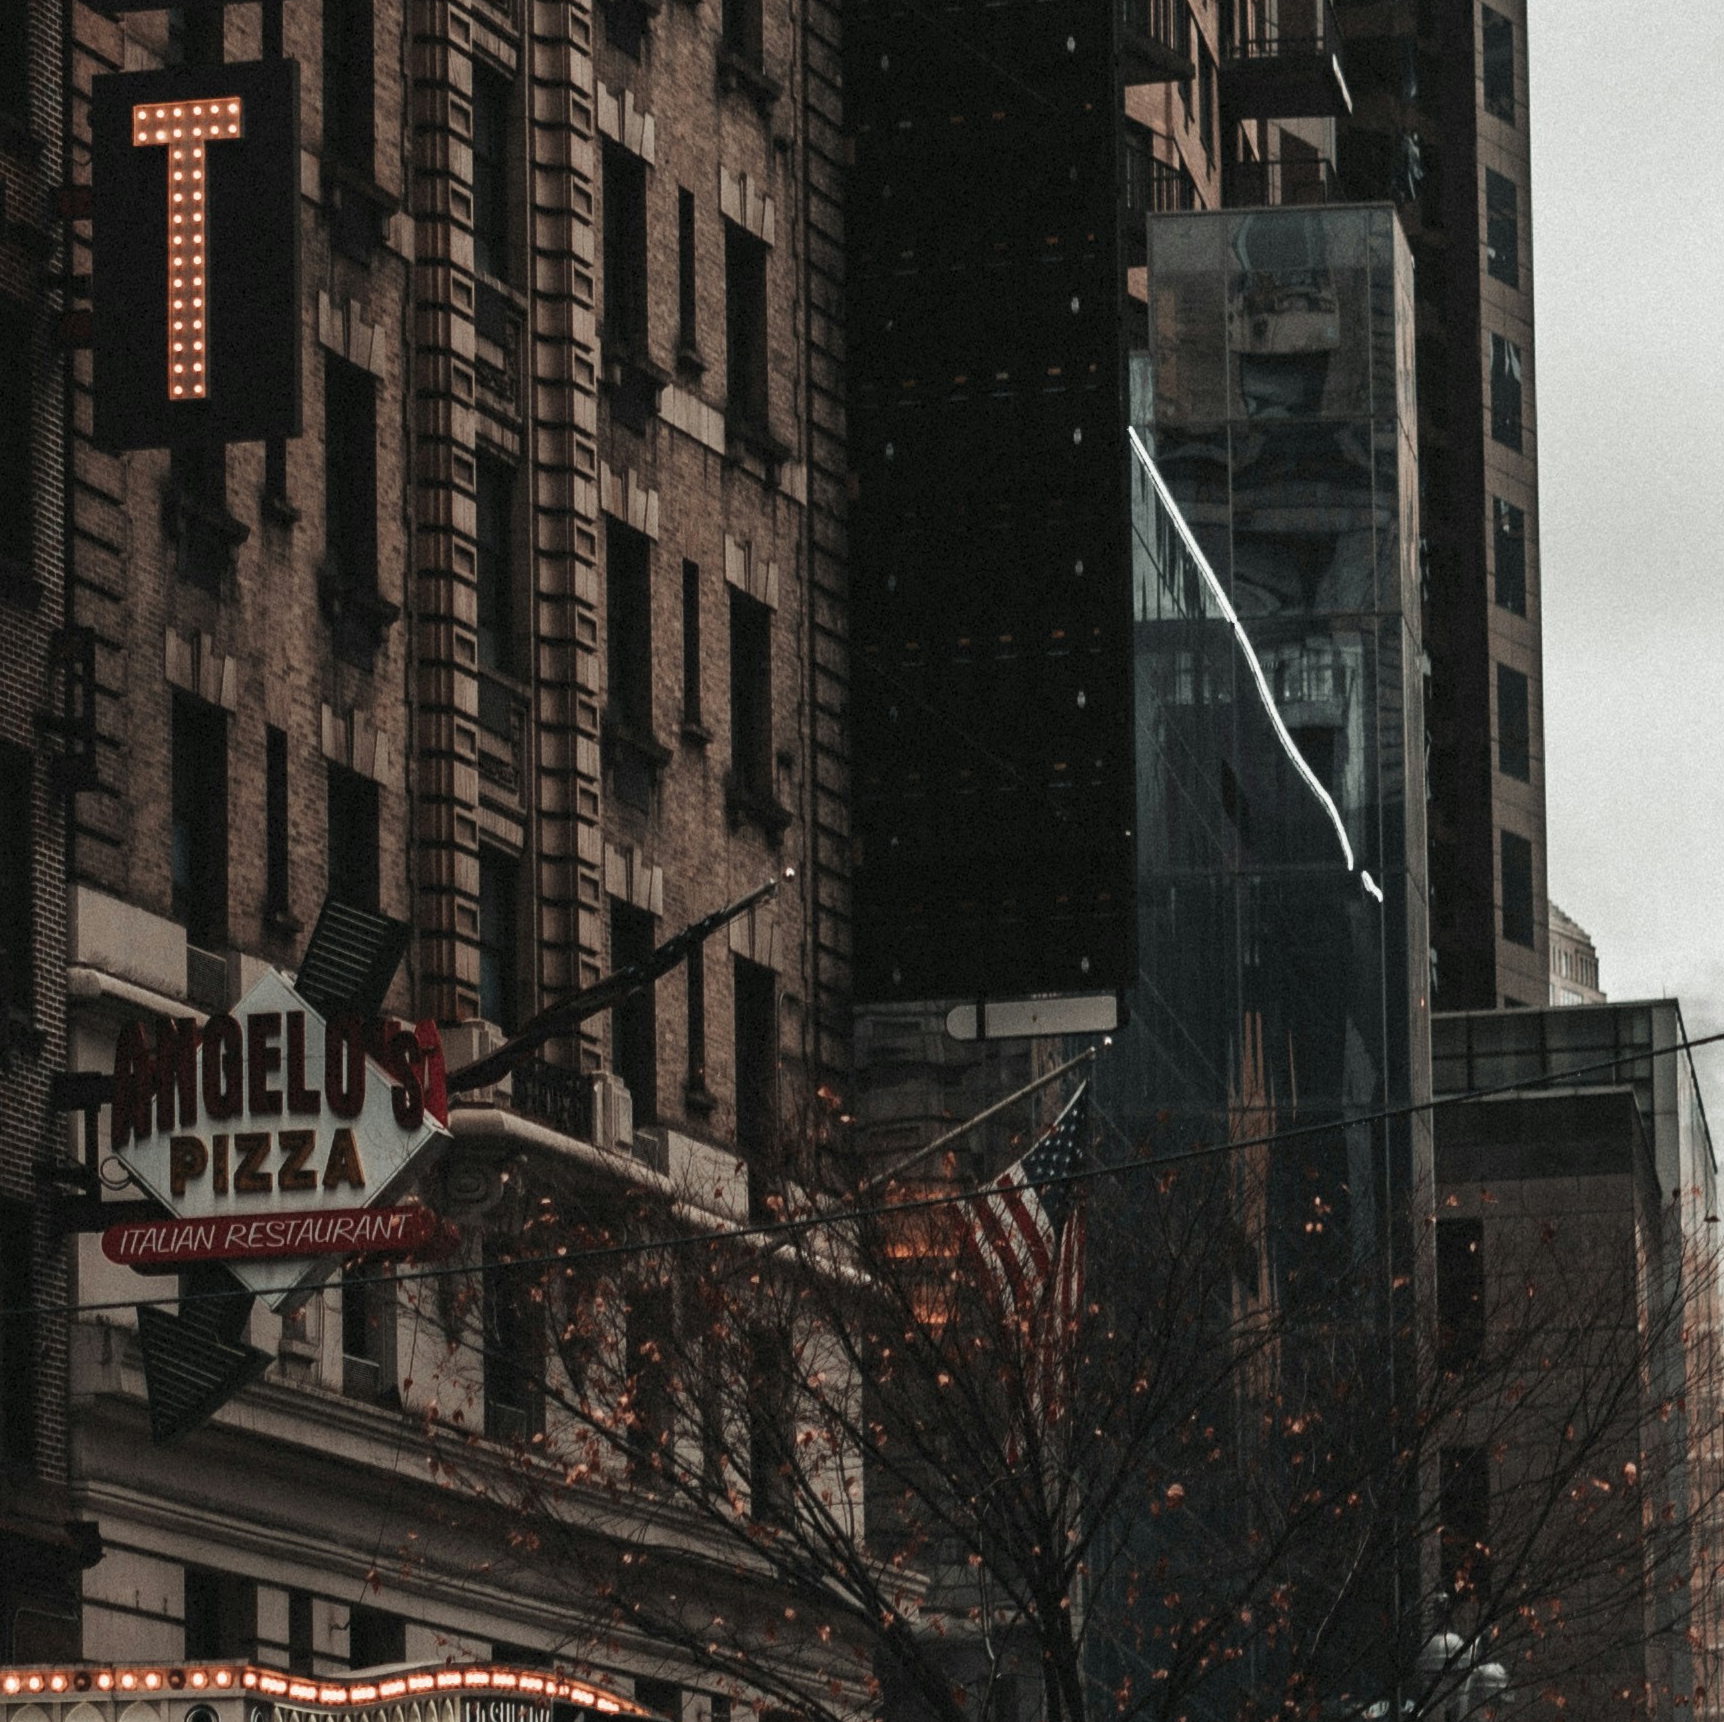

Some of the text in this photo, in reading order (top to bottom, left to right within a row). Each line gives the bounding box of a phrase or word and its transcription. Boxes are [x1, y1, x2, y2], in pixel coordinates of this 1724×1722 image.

[110, 1010, 426, 1151] ANGELO'S
[170, 1127, 366, 1197] PIZZA
[119, 1213, 414, 1256] ITALIAN RESTAURANT
